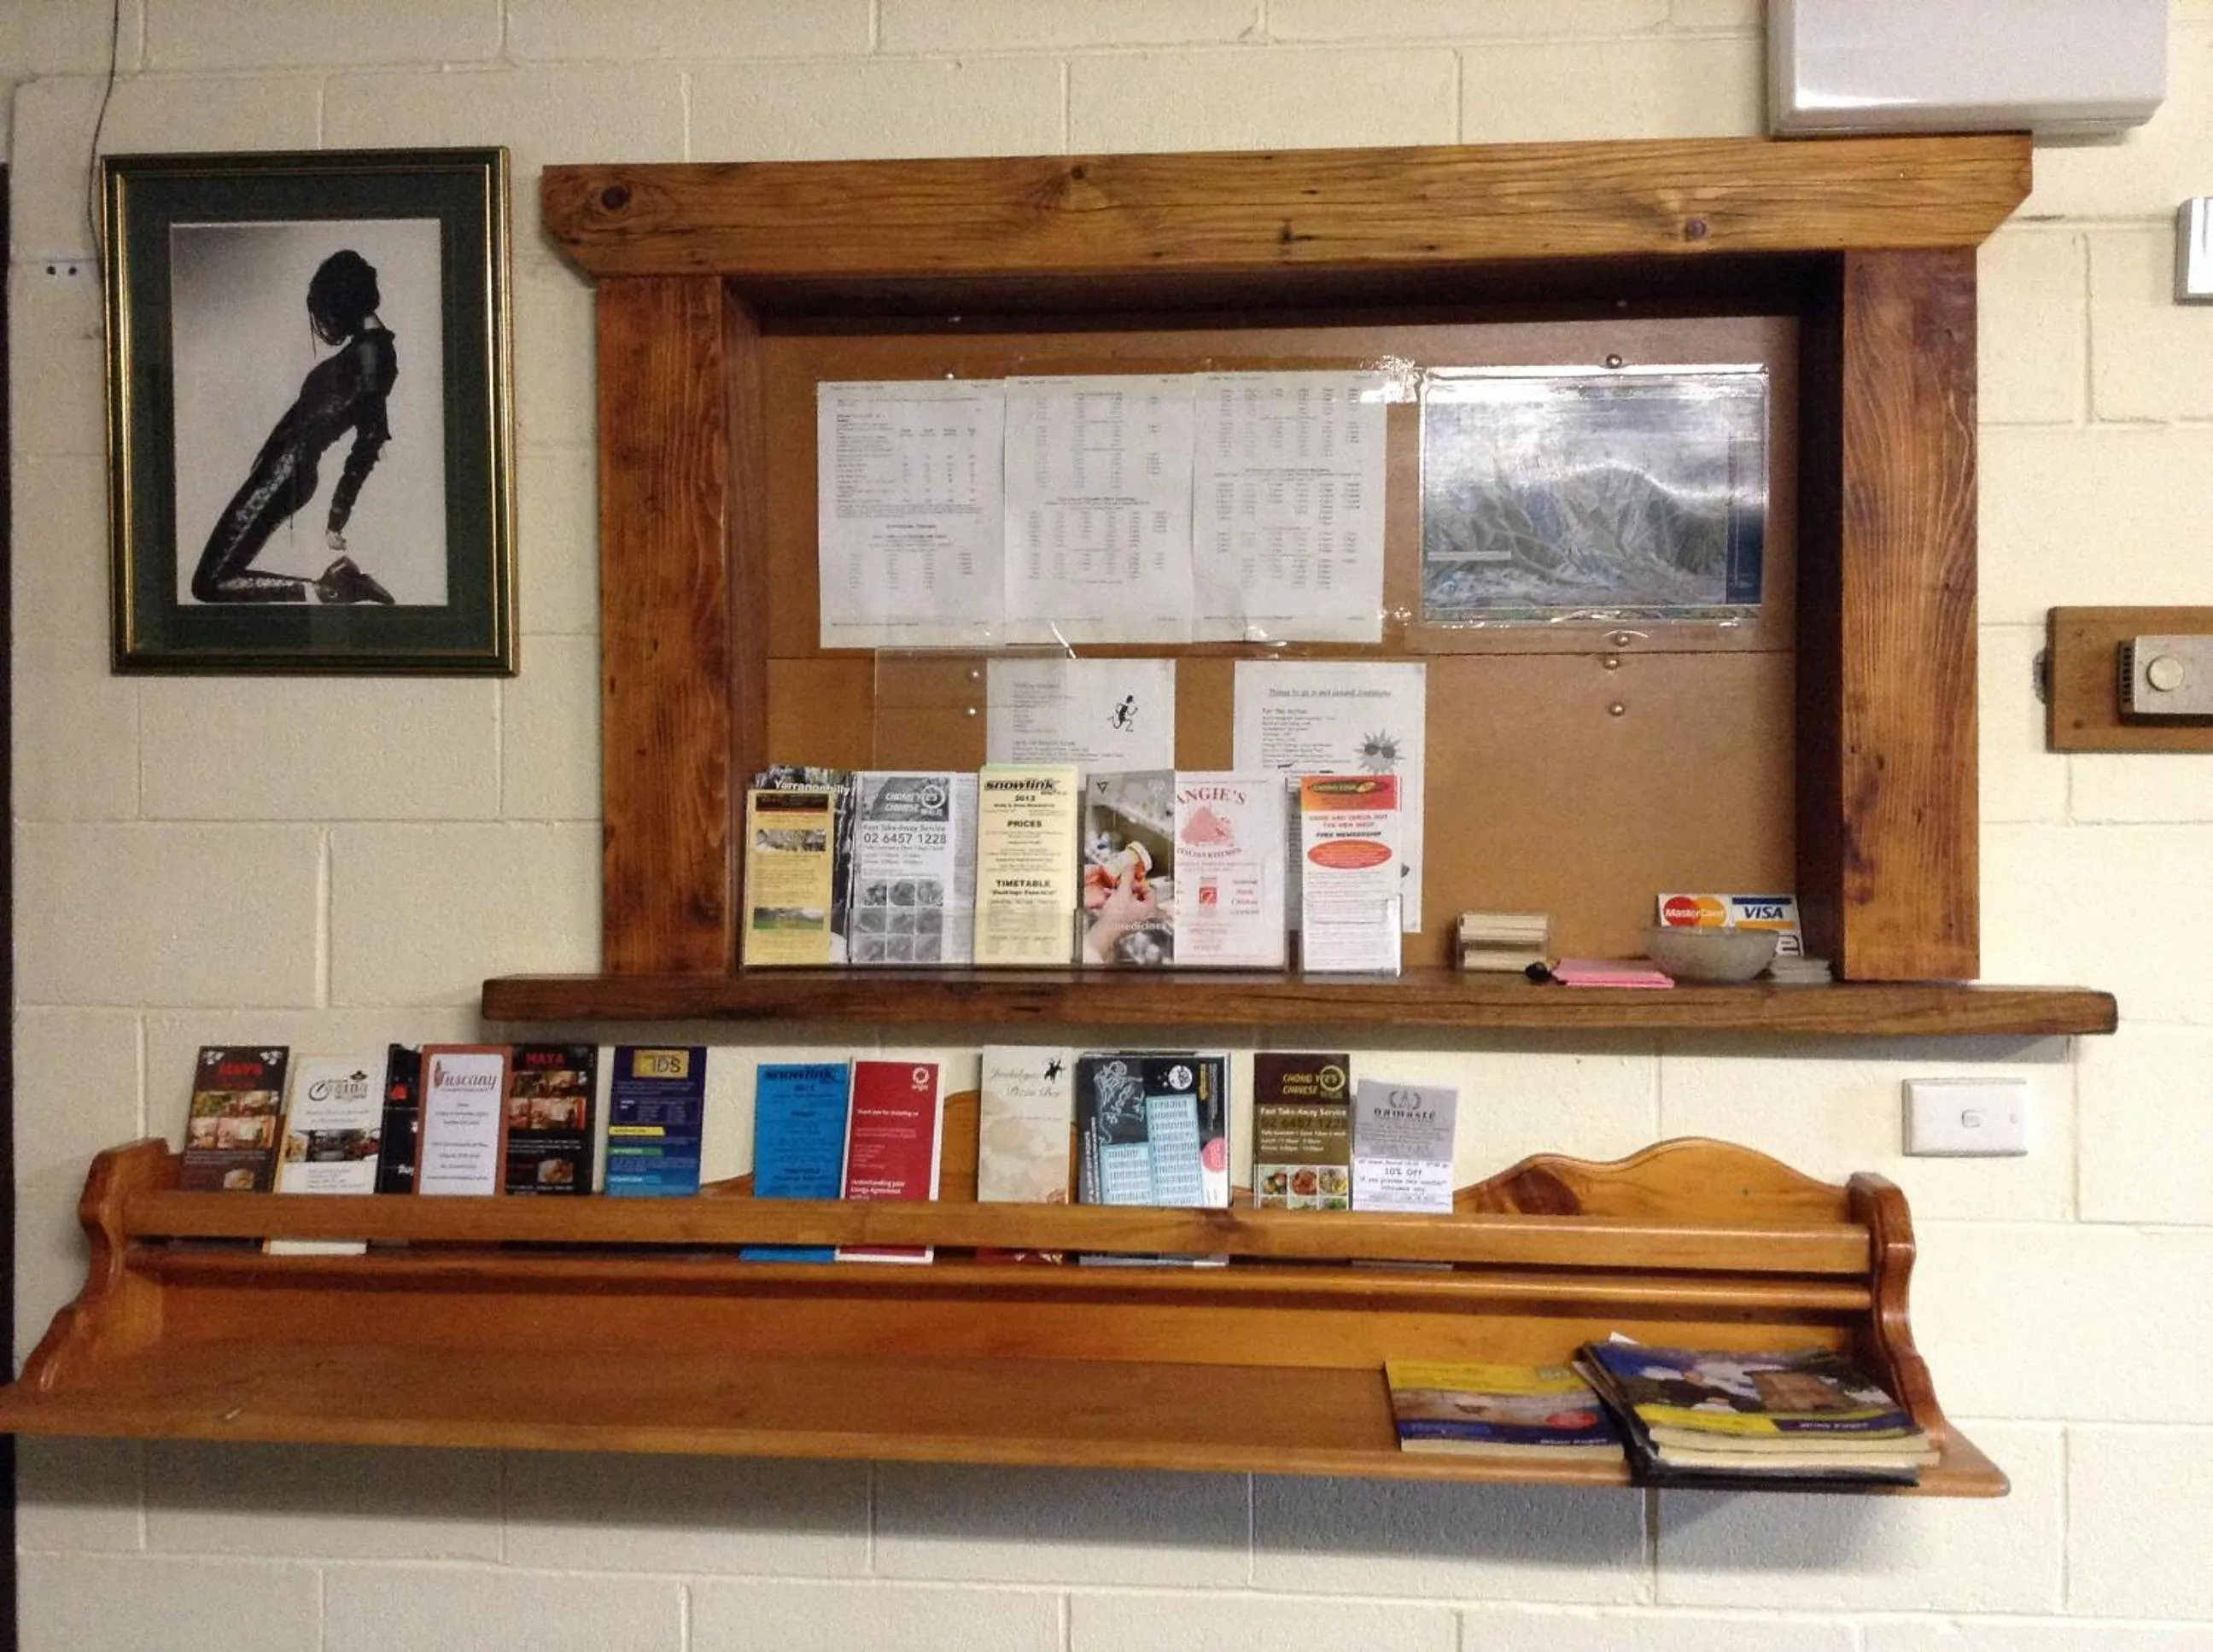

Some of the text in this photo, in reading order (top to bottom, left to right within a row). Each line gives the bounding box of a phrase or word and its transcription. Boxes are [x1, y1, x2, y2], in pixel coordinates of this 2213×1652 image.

[863, 832, 947, 844] 02 6457 1228
[1665, 907, 1725, 919] MasterCard
[1743, 906, 1784, 919] VISA
[1261, 1106, 1276, 1115] Fast
[1319, 1106, 1347, 1117] Service
